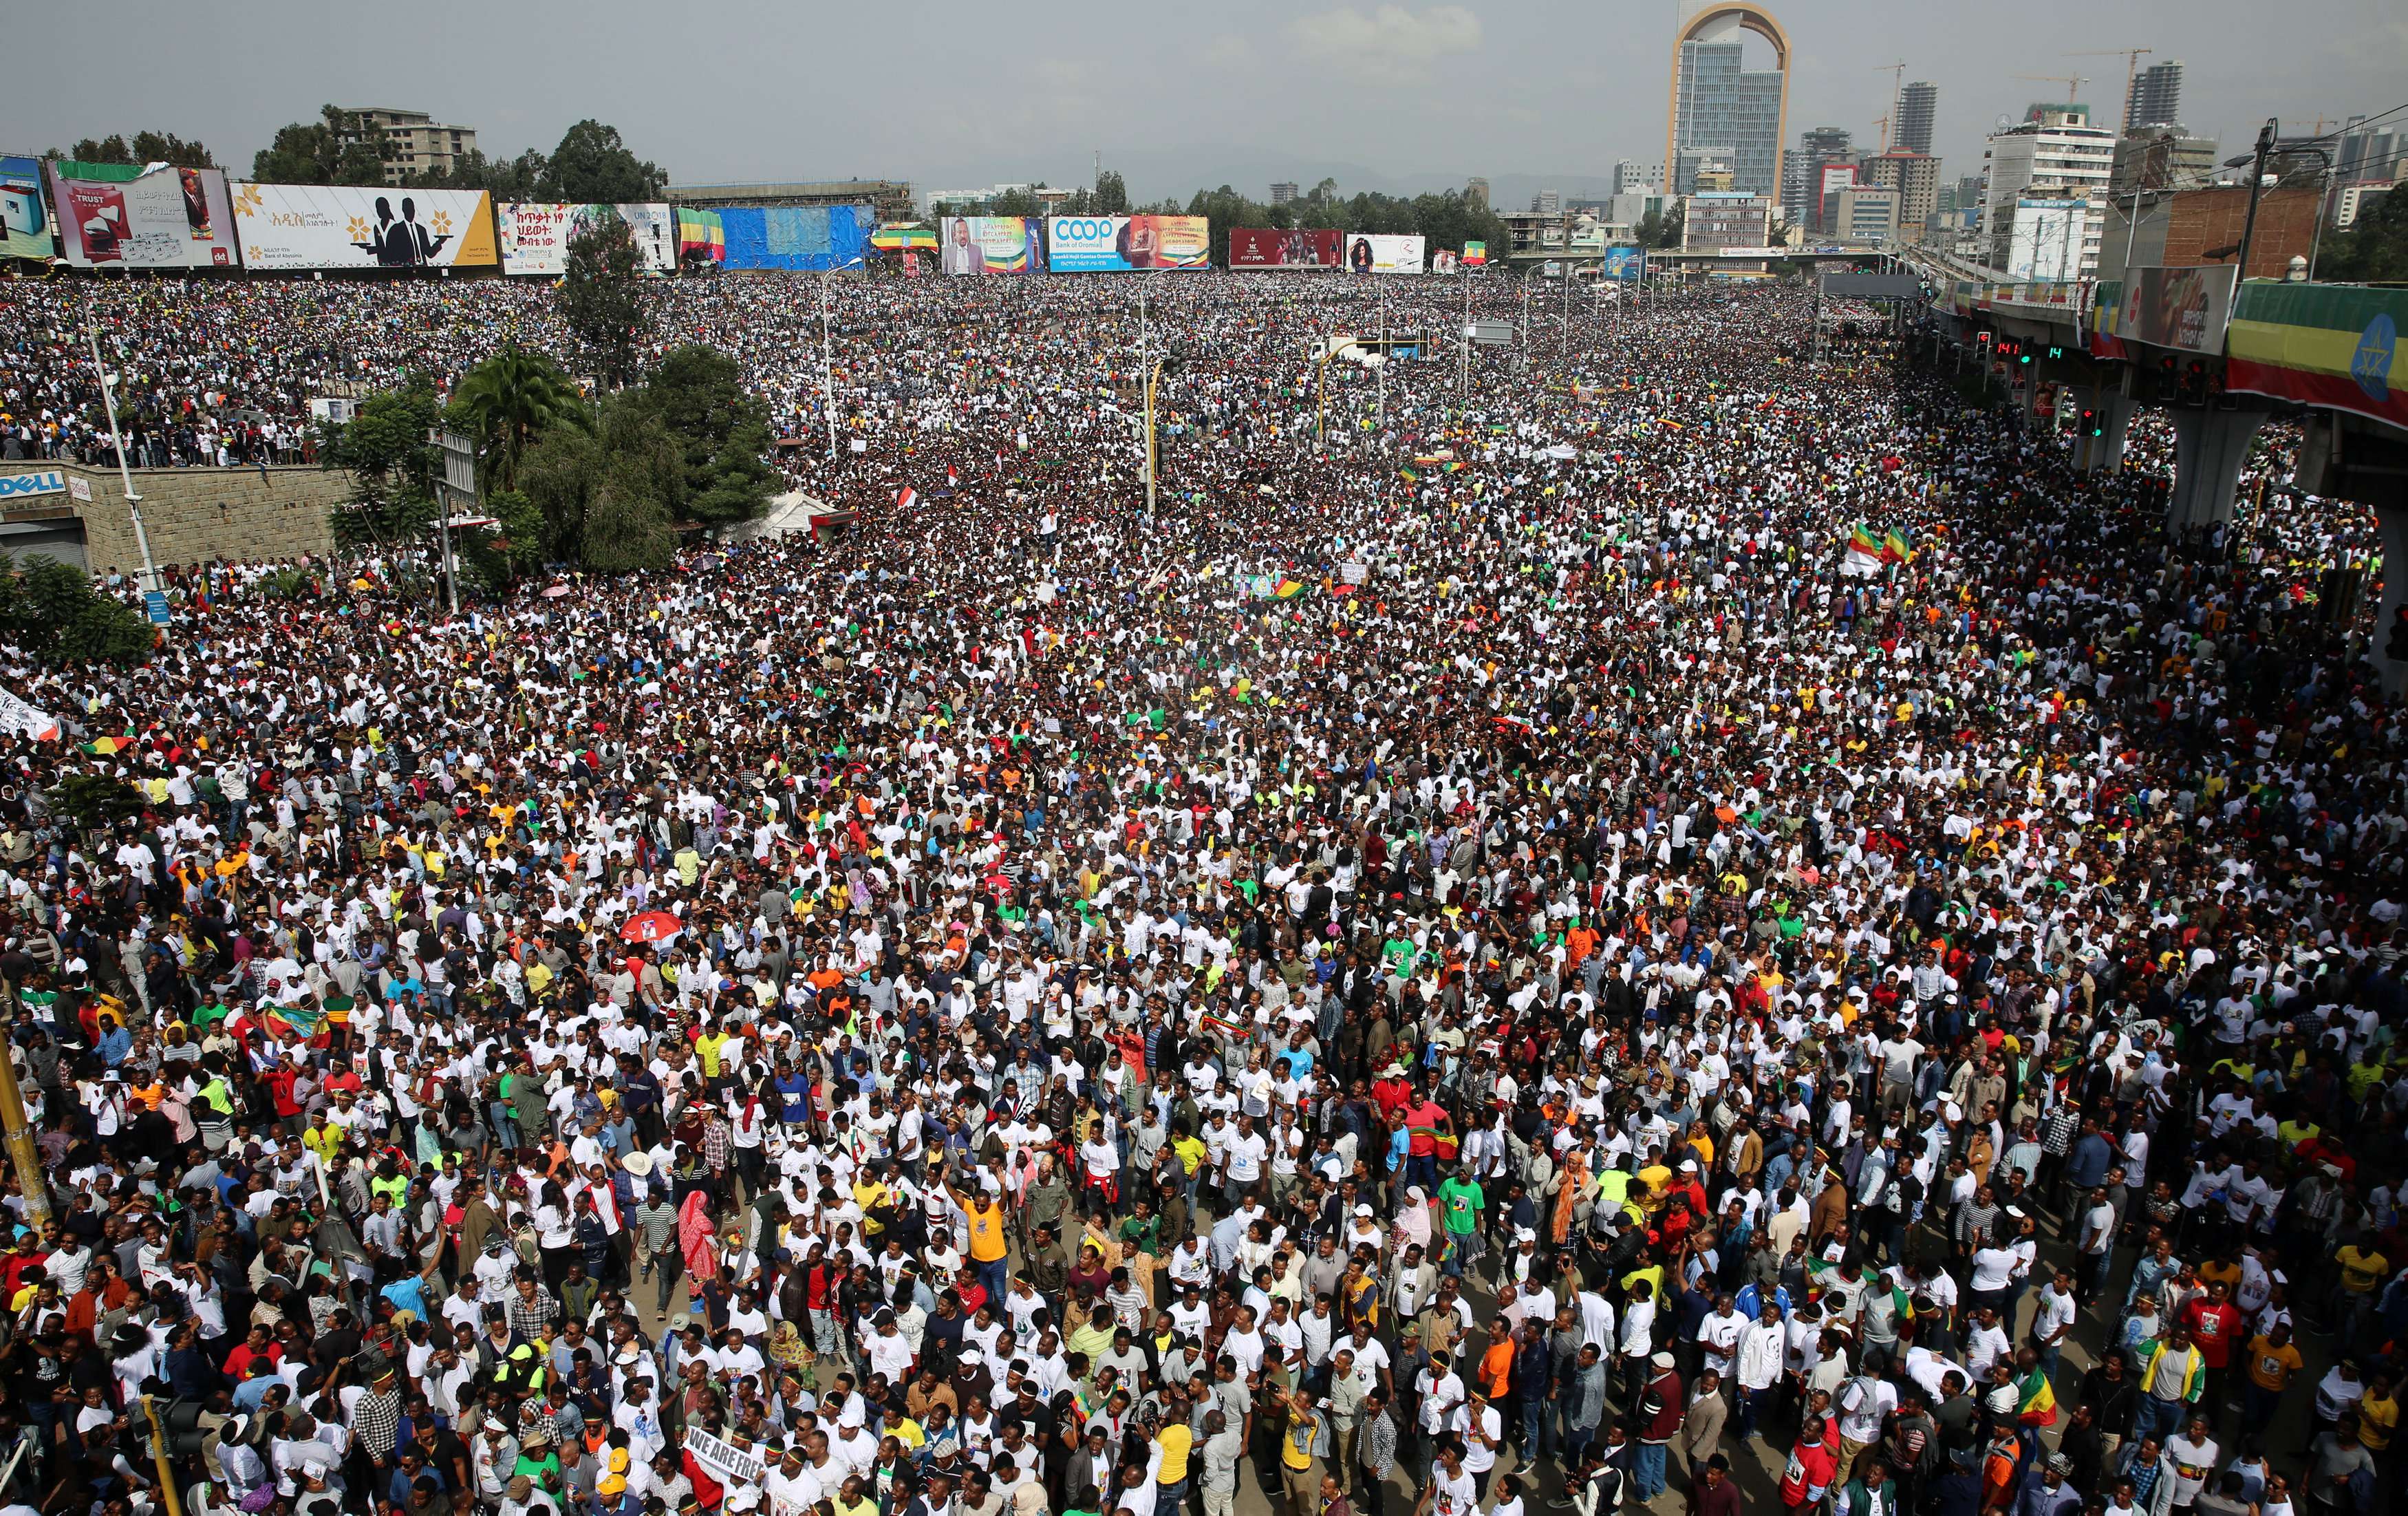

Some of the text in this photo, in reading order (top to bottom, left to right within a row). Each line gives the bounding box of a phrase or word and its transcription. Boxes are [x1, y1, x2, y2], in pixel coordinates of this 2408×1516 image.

[76, 195, 104, 203] TRUST
[272, 212, 303, 227] አዲስ
[517, 212, 551, 224] ከጥቃት
[517, 237, 540, 246] መብቴ
[2050, 348, 2061, 358] 14
[0, 473, 64, 495] DELL
[1180, 1319, 1201, 1327] Ethiopia
[689, 1428, 711, 1455] WE
[709, 1442, 737, 1469] ARE
